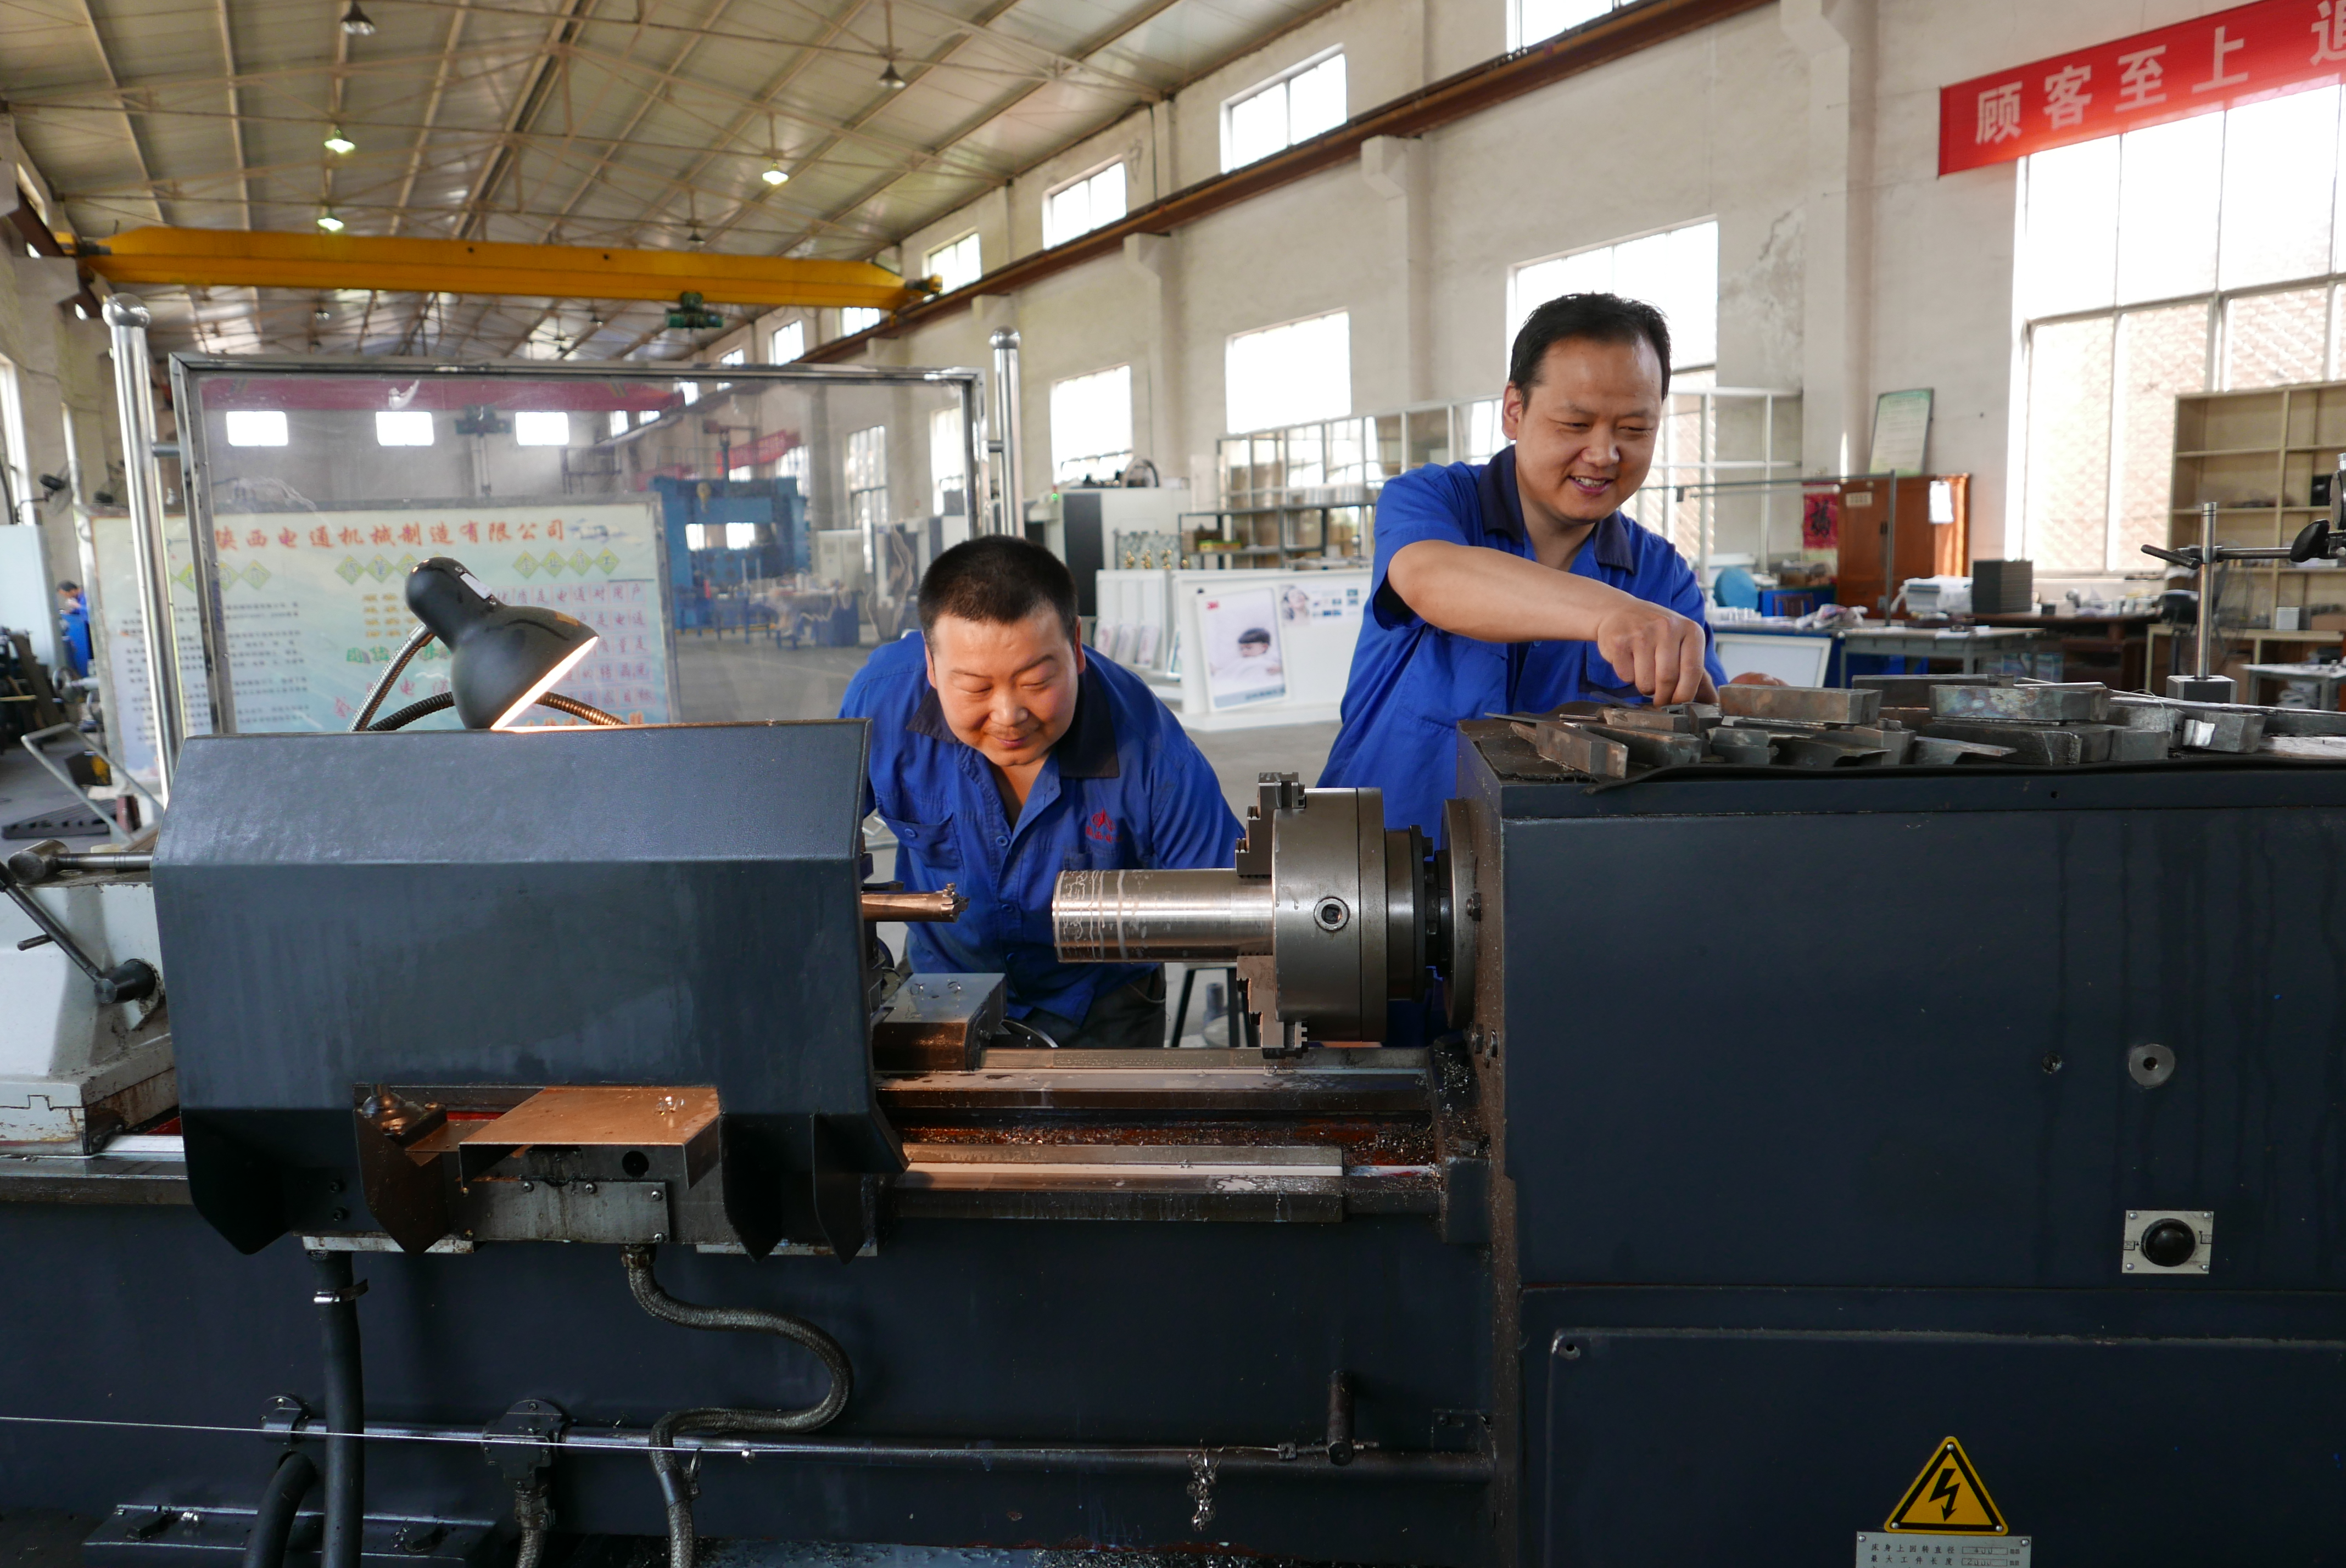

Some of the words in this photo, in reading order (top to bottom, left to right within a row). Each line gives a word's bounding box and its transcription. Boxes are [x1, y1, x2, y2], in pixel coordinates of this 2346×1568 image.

[1975, 25, 2249, 145] 顾客至上
[215, 519, 565, 551] 陕西电通机械制造有限公司
